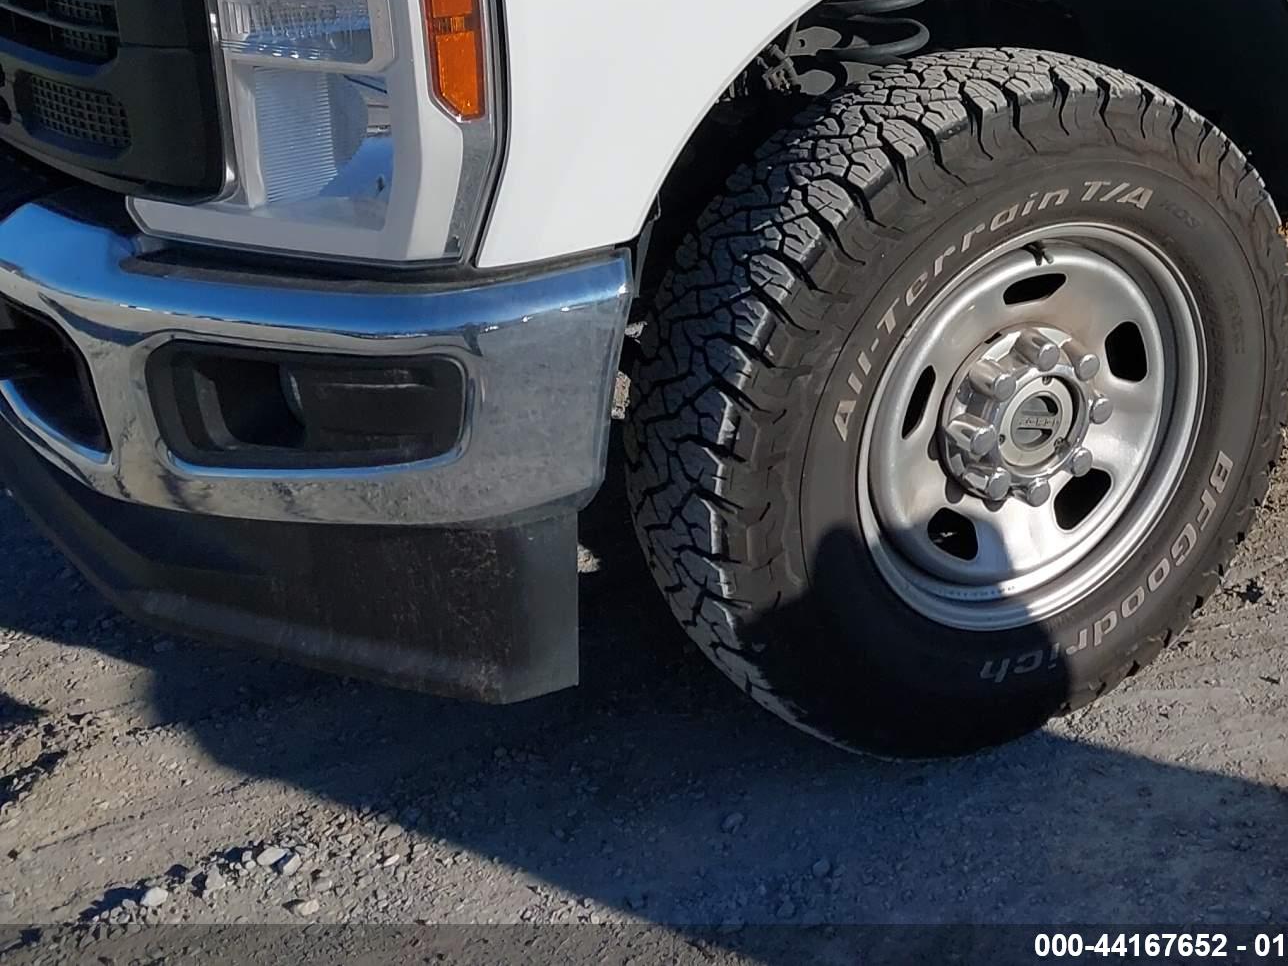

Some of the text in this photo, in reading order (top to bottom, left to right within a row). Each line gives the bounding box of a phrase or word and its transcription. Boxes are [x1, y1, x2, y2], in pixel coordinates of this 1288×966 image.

[832, 184, 1069, 443] All-Terrain
[1080, 180, 1154, 211] T/A
[980, 449, 1234, 684] BFGoodrich
